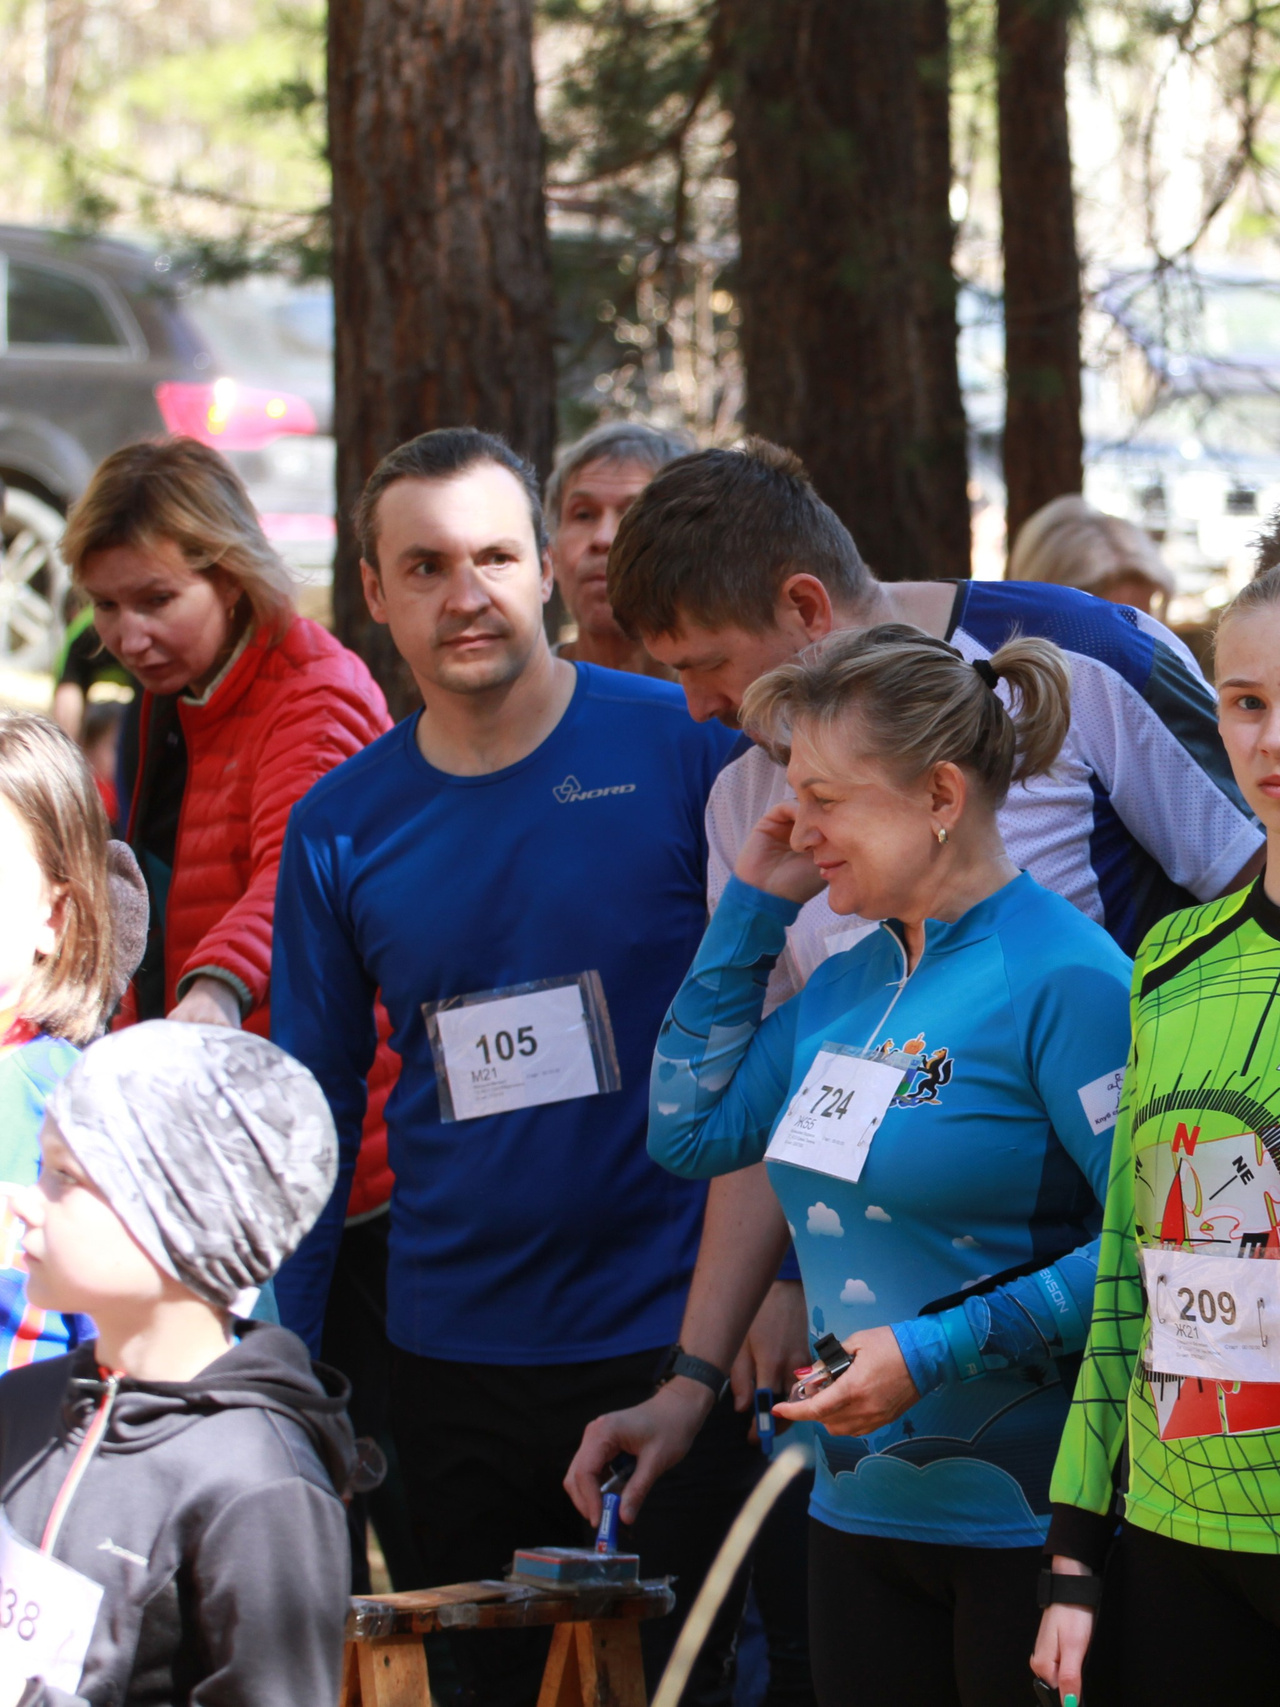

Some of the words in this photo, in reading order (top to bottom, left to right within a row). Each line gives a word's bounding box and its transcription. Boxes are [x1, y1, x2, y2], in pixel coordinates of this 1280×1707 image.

[569, 783, 637, 803] NORD
[475, 1025, 538, 1065] 105
[810, 1085, 856, 1120] 724
[1172, 1122, 1201, 1156] N
[1232, 1155, 1254, 1186] NE
[1177, 1287, 1237, 1326] 209
[1174, 1322, 1199, 1339] Ж21
